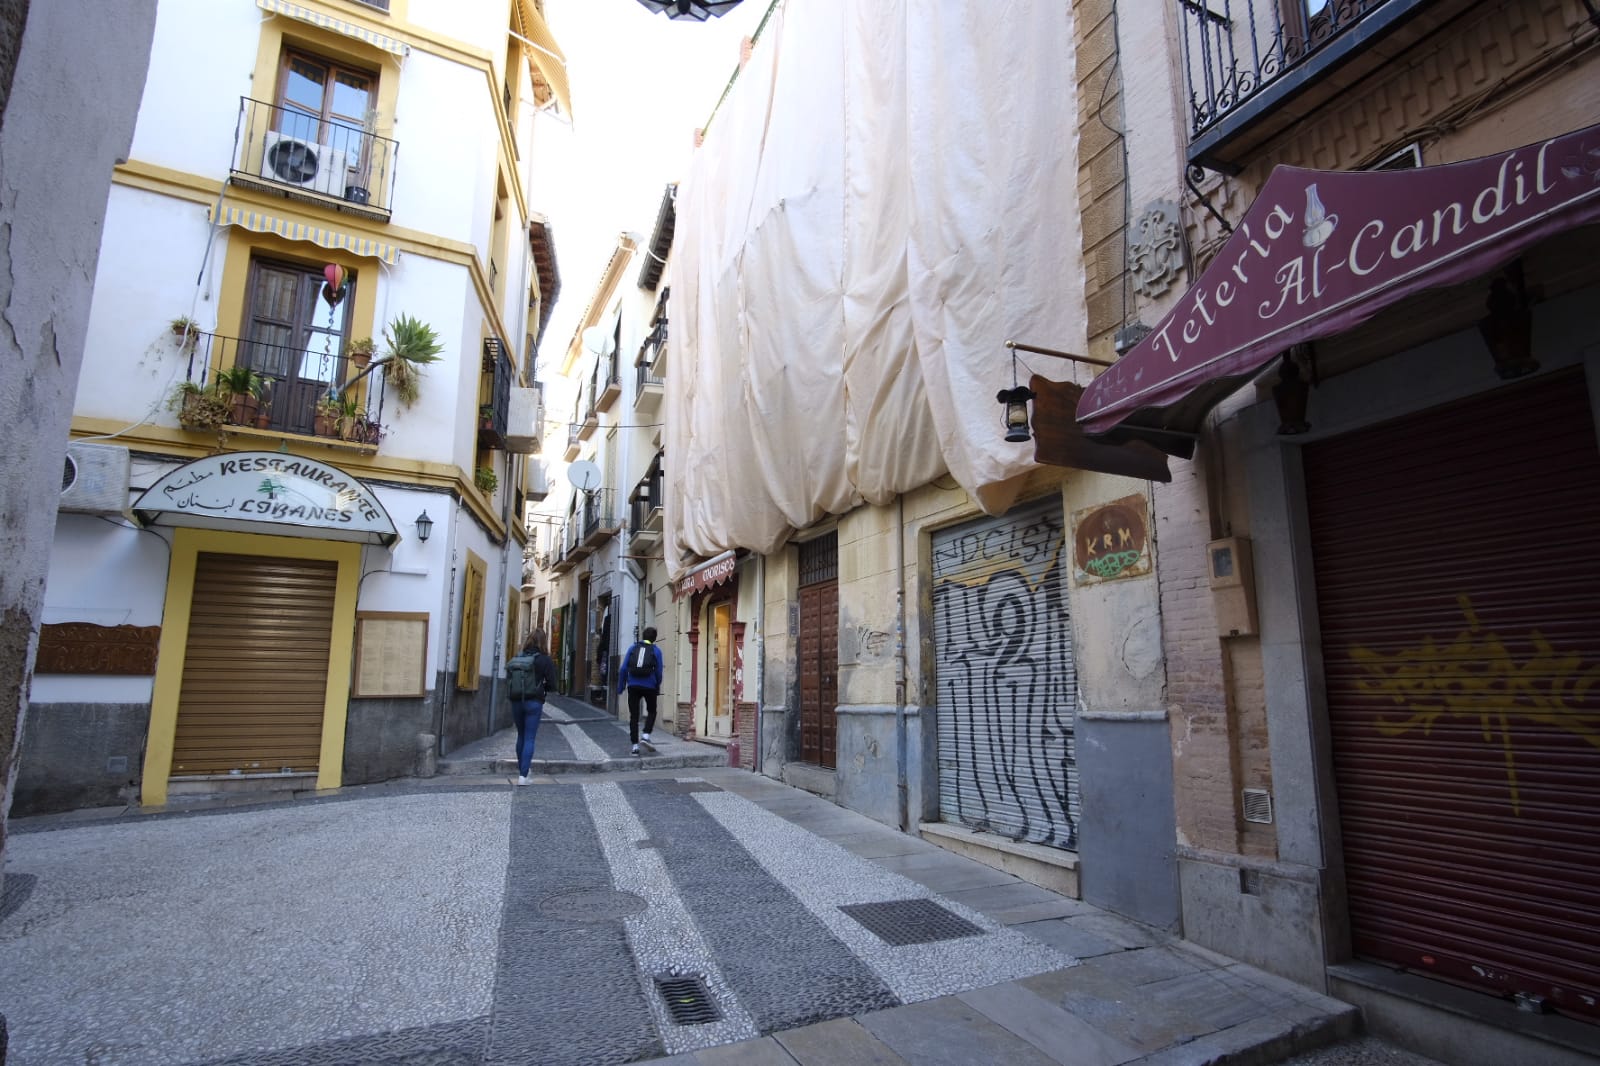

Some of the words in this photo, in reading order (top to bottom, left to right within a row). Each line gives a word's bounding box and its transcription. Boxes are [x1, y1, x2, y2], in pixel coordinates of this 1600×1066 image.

[1151, 204, 1295, 362] Tetería
[1258, 139, 1558, 319] Al-Candil
[220, 458, 381, 522] RESTAURANTE
[238, 499, 353, 523] LIBANES
